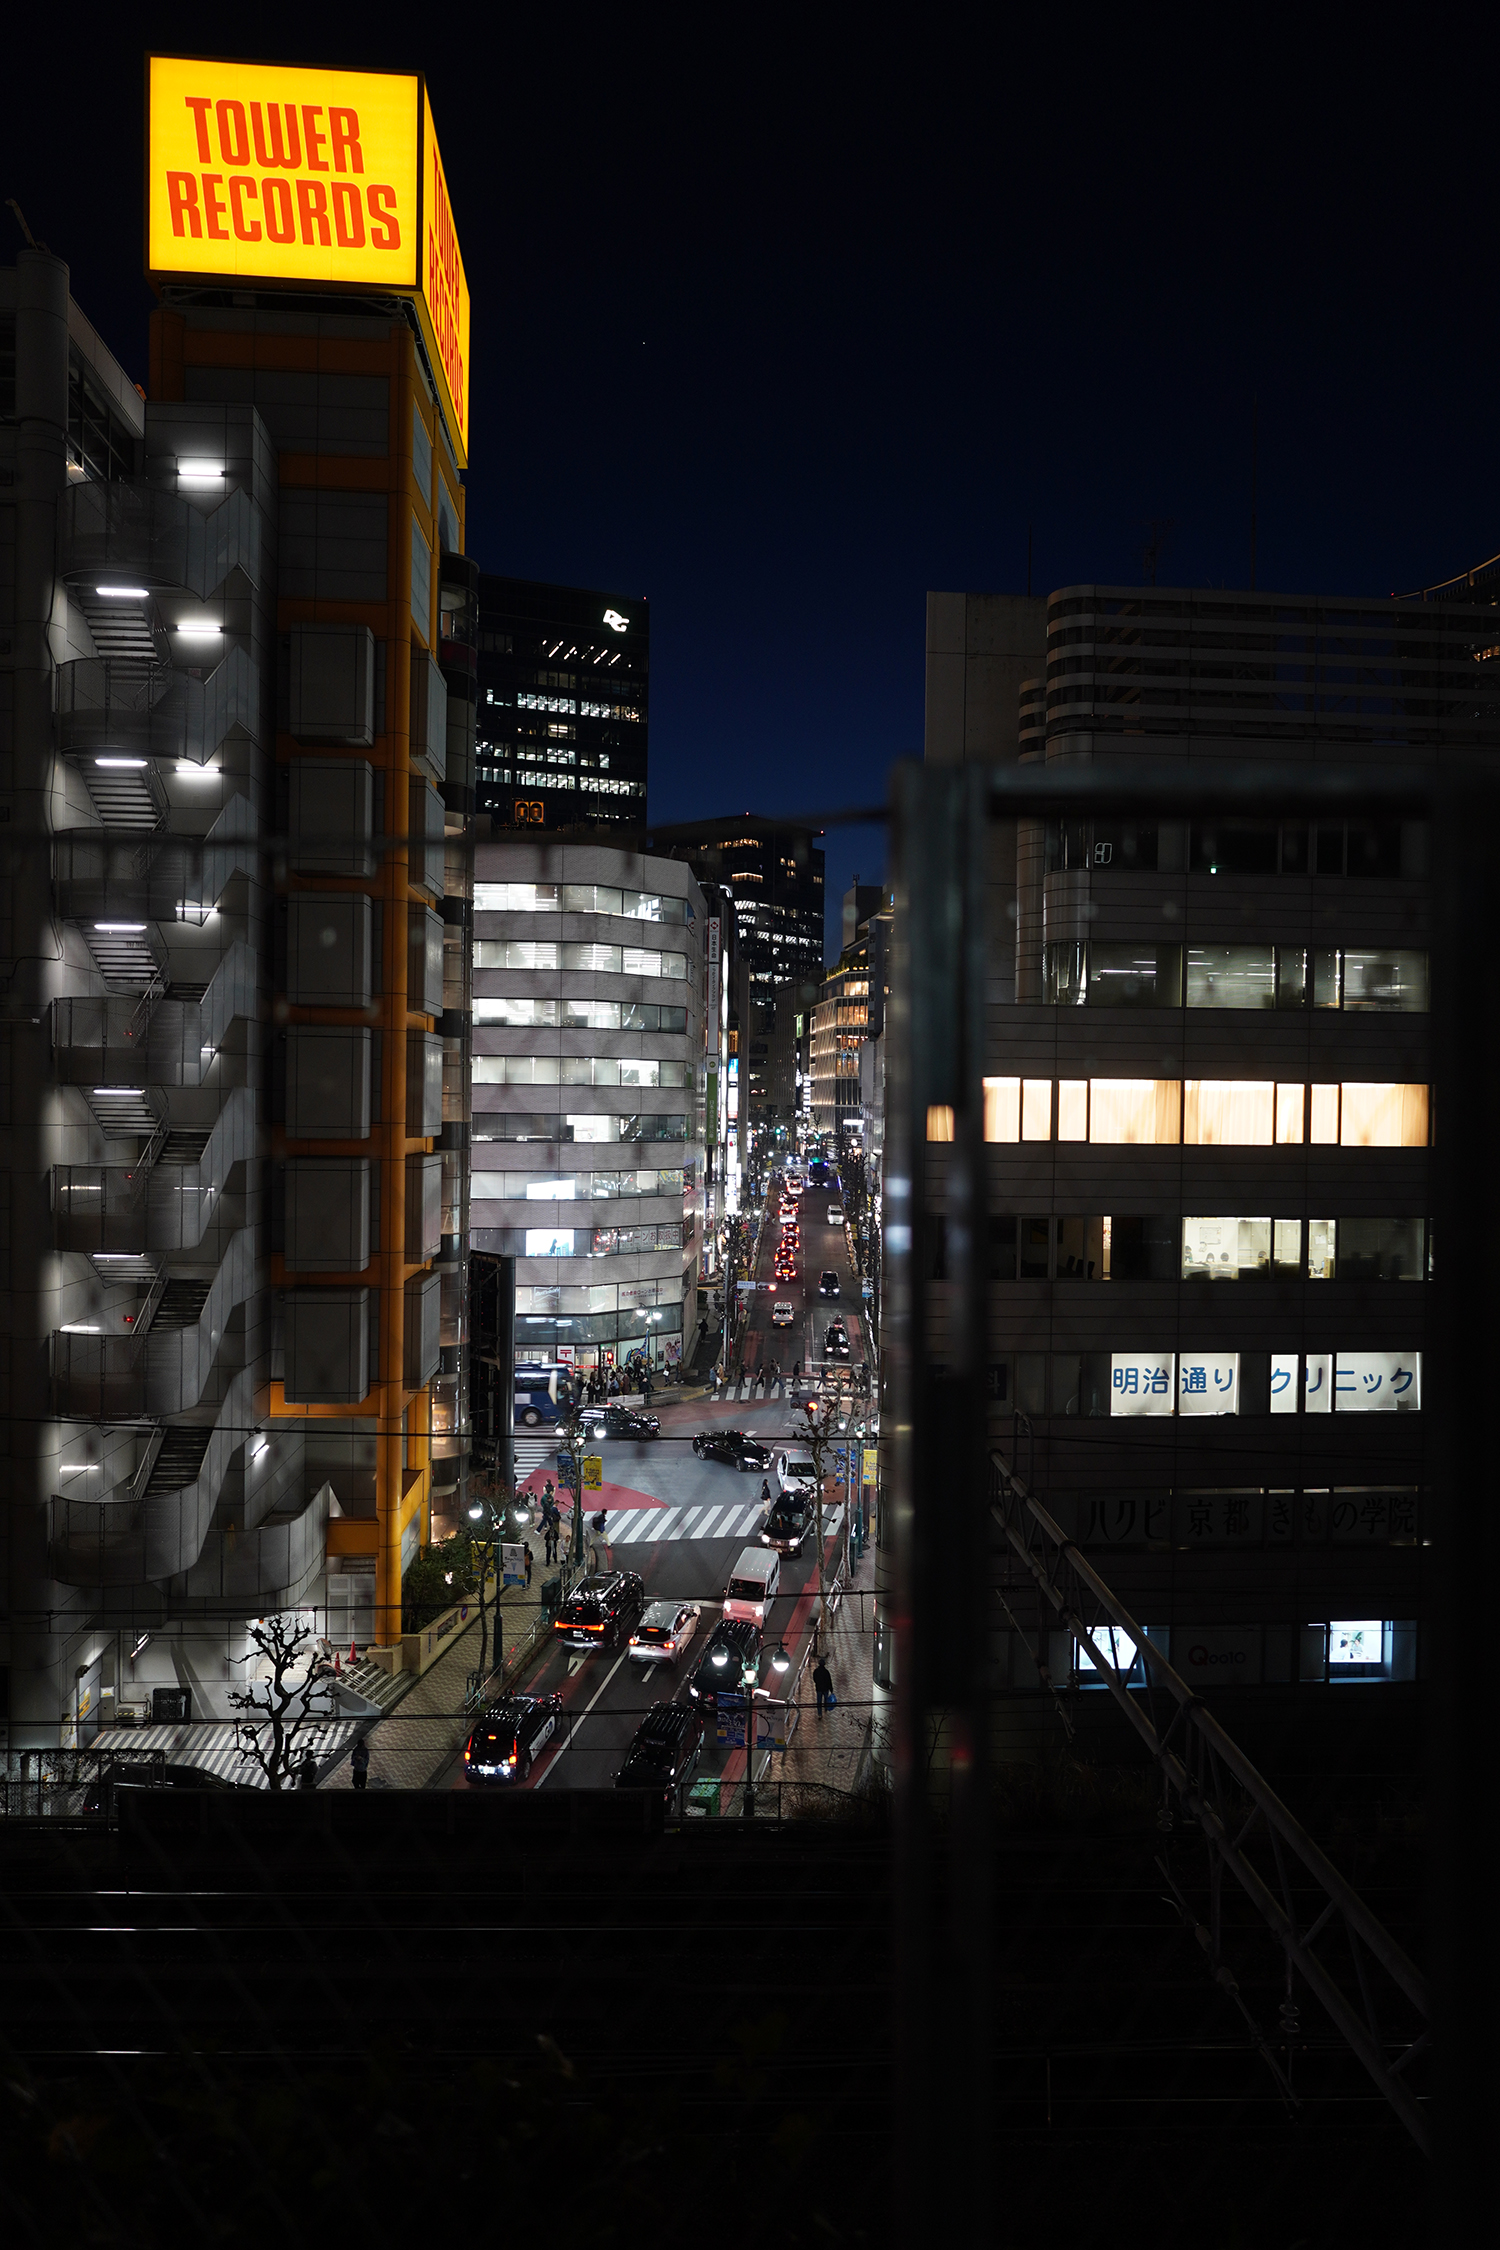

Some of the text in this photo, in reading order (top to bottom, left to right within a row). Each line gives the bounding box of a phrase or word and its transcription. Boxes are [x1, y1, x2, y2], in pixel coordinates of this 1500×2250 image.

[184, 96, 365, 174] TOWER
[166, 170, 402, 250] RECORDS
[432, 142, 461, 324] TOWER
[428, 221, 465, 434] RECORDS
[1113, 1366, 1416, 1396] 明治通り クリニック
[1084, 1499, 1167, 1542] ハクビ
[1187, 1644, 1247, 1667] Qoo10
